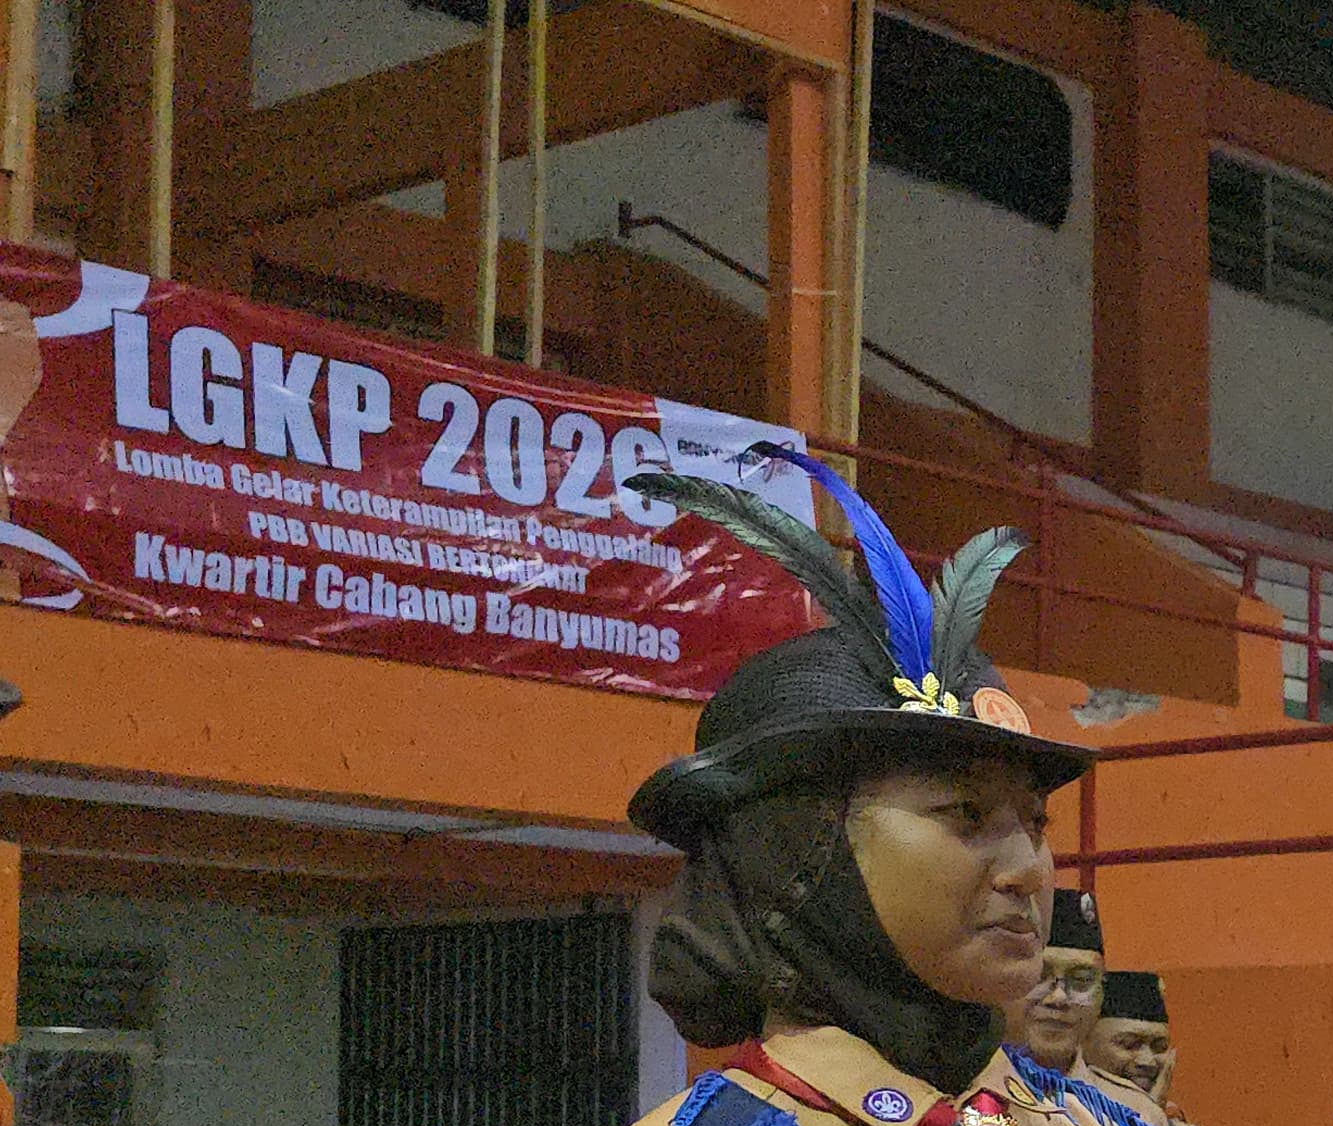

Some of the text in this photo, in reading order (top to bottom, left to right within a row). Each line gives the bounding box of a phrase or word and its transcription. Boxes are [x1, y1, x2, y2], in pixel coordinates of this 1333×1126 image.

[112, 309, 677, 527] LGKP 2026
[114, 440, 683, 574] Lomba Gelar Keterampilan Penggalang
[249, 511, 590, 594] PBB VARIASI BERTONGKAT
[134, 531, 680, 663] Kwartir Cabang Banyumas
